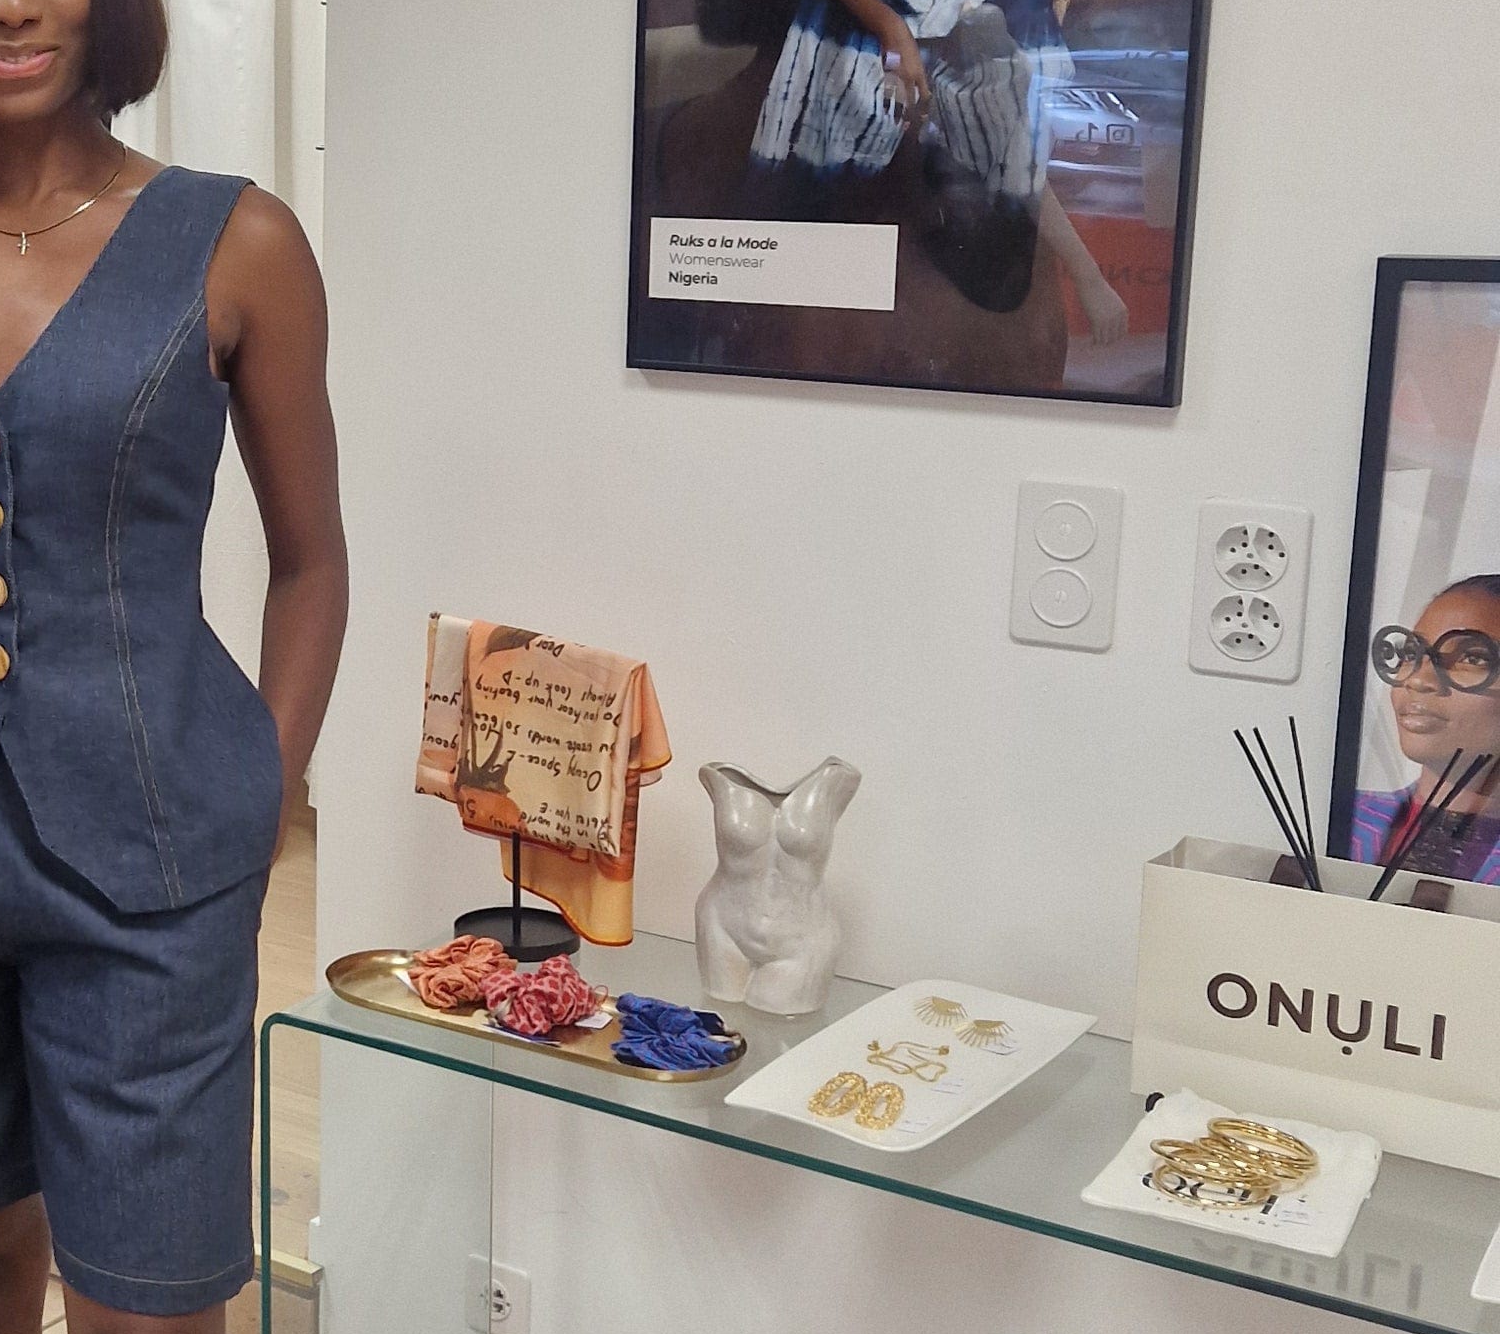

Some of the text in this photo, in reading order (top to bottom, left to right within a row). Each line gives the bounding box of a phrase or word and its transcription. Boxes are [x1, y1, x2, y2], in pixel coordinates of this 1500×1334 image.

[669, 234, 779, 250] Ruks a la Mode
[668, 252, 765, 268] Womenswear
[668, 271, 718, 287] Nigeria
